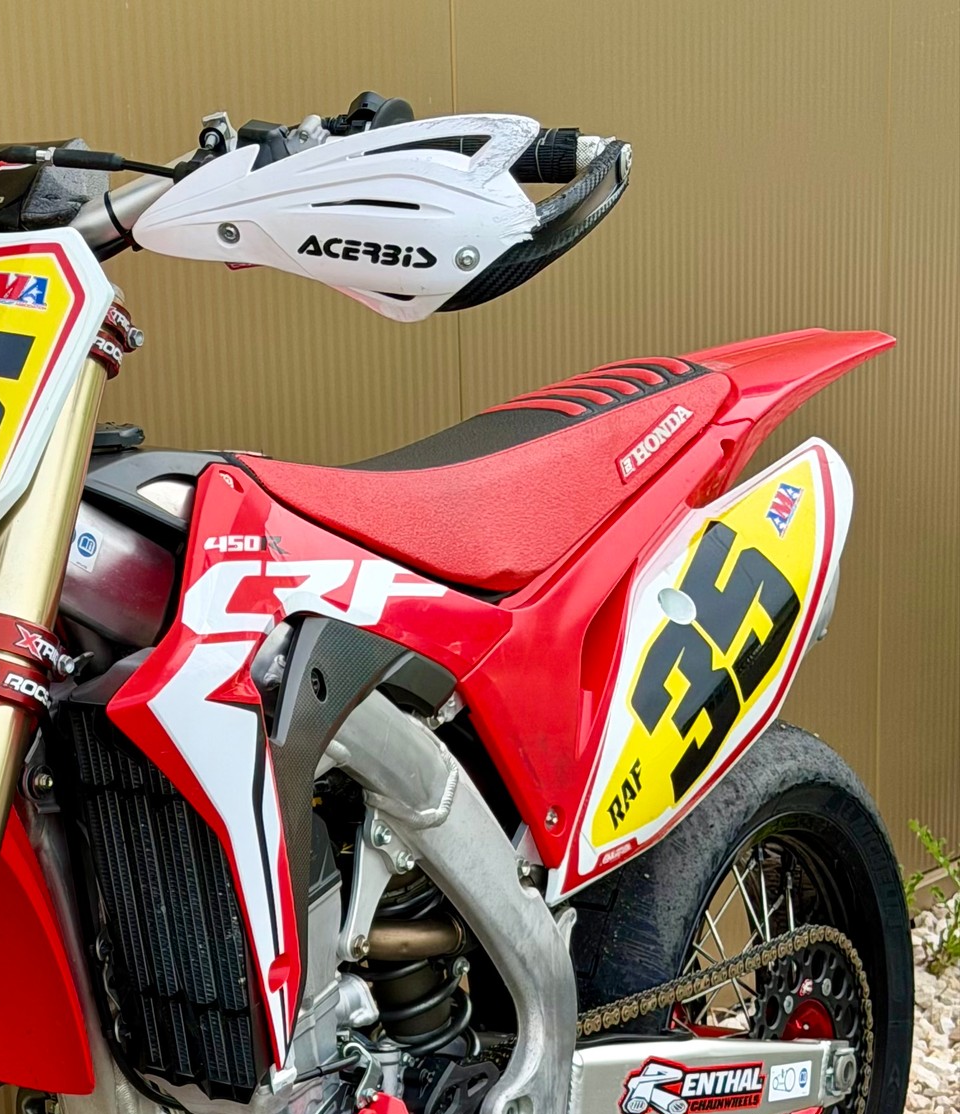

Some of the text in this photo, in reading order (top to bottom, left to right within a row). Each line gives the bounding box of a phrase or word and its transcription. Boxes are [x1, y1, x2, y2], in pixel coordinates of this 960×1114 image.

[631, 405, 694, 468] HONDA
[766, 483, 801, 537] AMA
[181, 559, 449, 635] CRF
[14, 623, 60, 665] XTRI
[631, 521, 802, 805] 35
[607, 758, 642, 831] RAF
[690, 1094, 759, 1113] CHAINWHEELS
